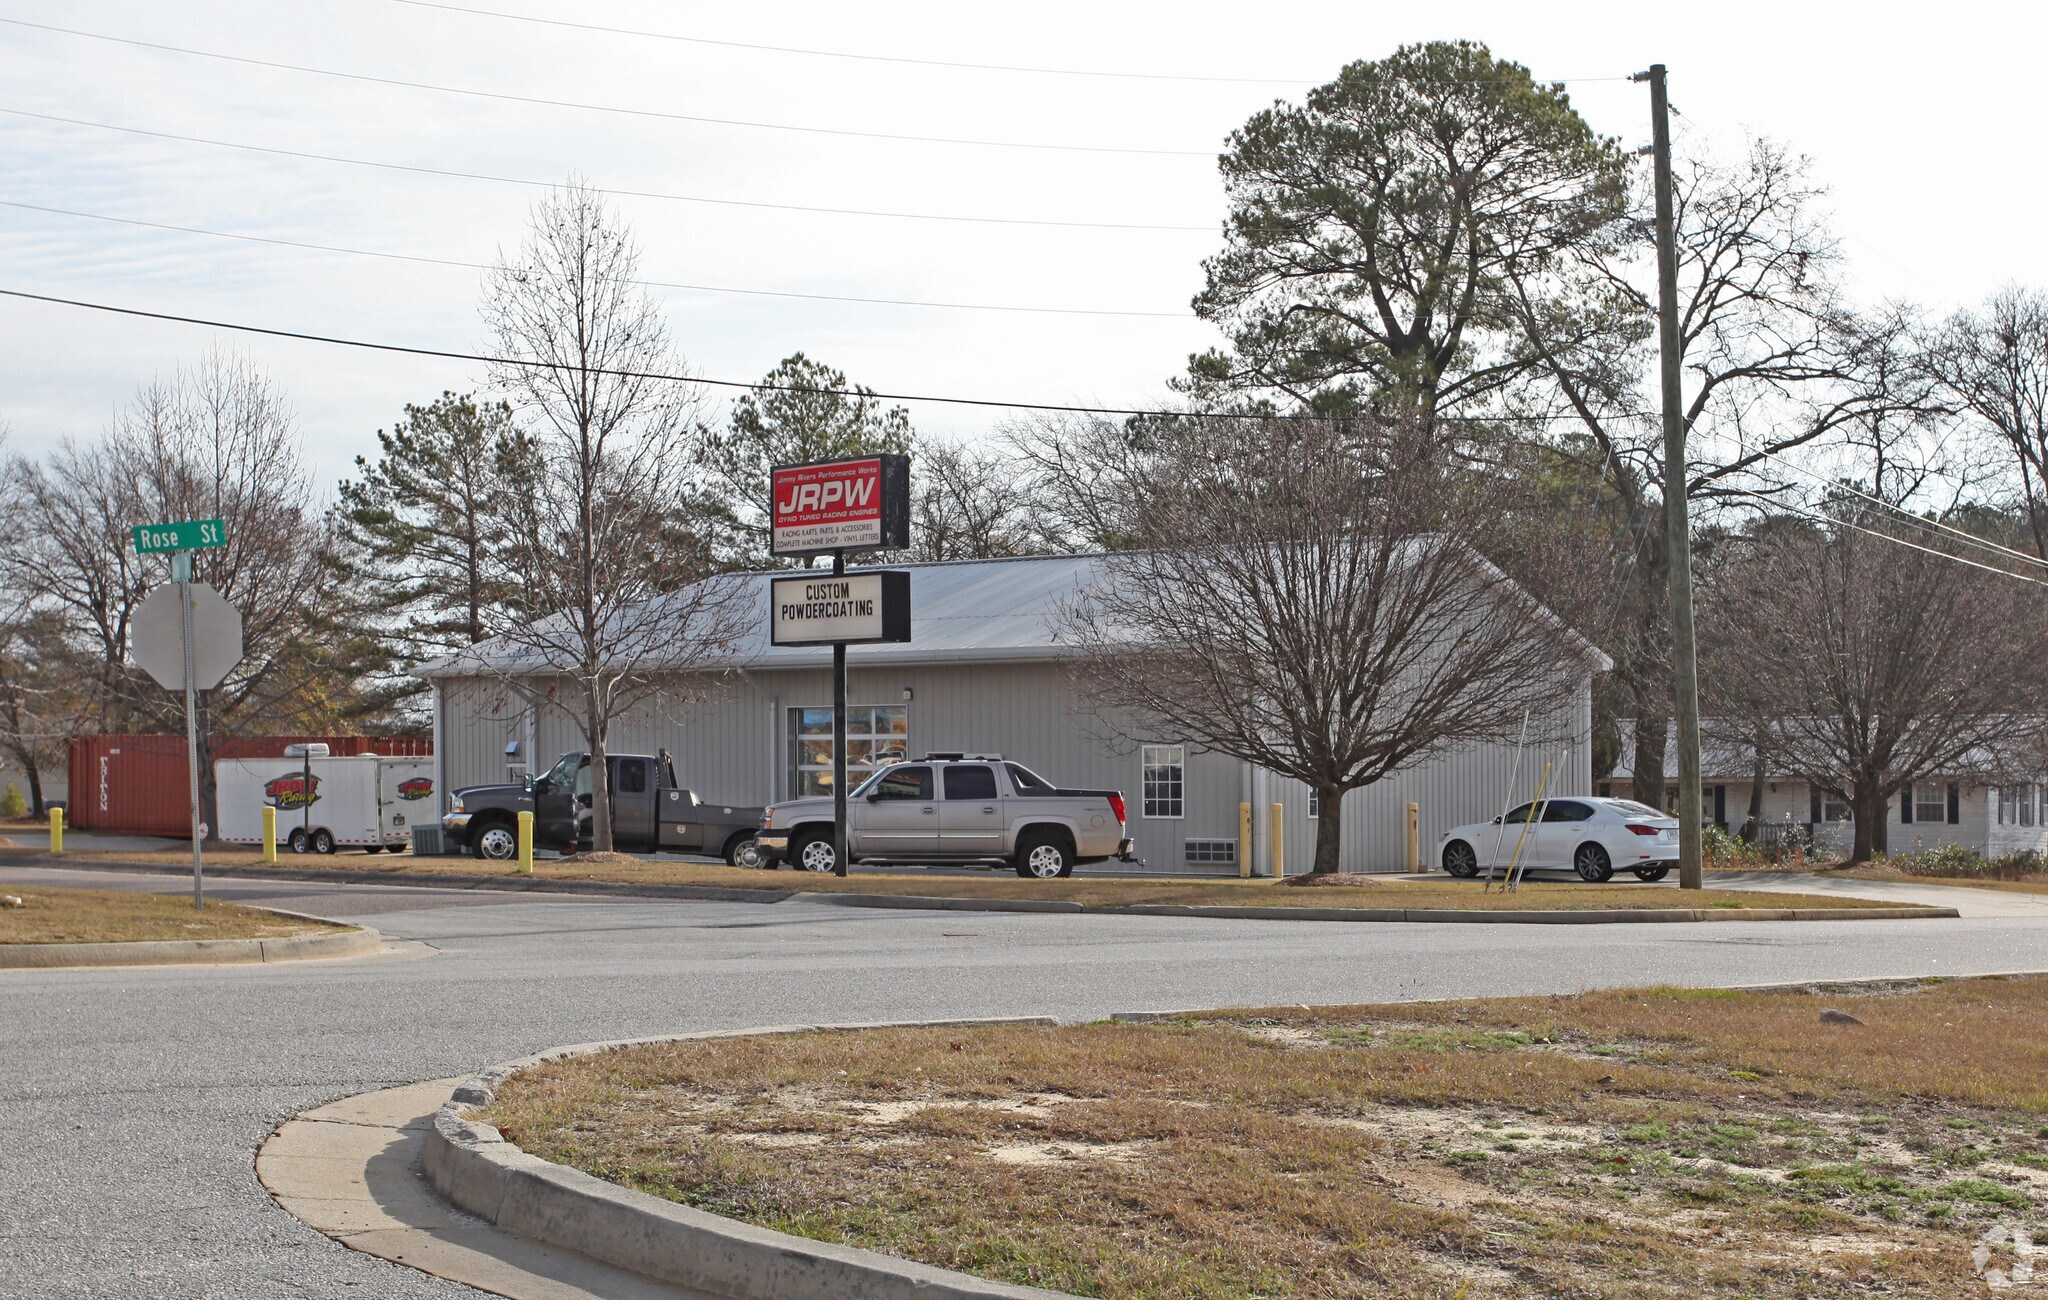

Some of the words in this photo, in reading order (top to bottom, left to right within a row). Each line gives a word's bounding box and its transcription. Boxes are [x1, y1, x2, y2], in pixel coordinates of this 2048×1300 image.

[778, 476, 796, 484] Jimmy
[818, 470, 856, 479] Performance
[858, 466, 877, 475] Works
[778, 476, 876, 514] JRPW
[799, 513, 821, 521] TUNED
[822, 510, 848, 519] RACING
[849, 507, 878, 517] ENGINES
[140, 529, 179, 549] Rose
[200, 523, 218, 544] St
[782, 529, 801, 538] RACING
[841, 523, 873, 533] ACCESSORIES
[776, 539, 801, 549] COMPLETE
[802, 537, 824, 546] MACHINE
[825, 536, 839, 544] SHOP
[843, 535, 858, 543] VINYL
[859, 532, 879, 541] LETTERS
[806, 582, 850, 600] CUSTOM
[781, 600, 873, 620] POWDERCOATING
[100, 756, 108, 811] TRITON
